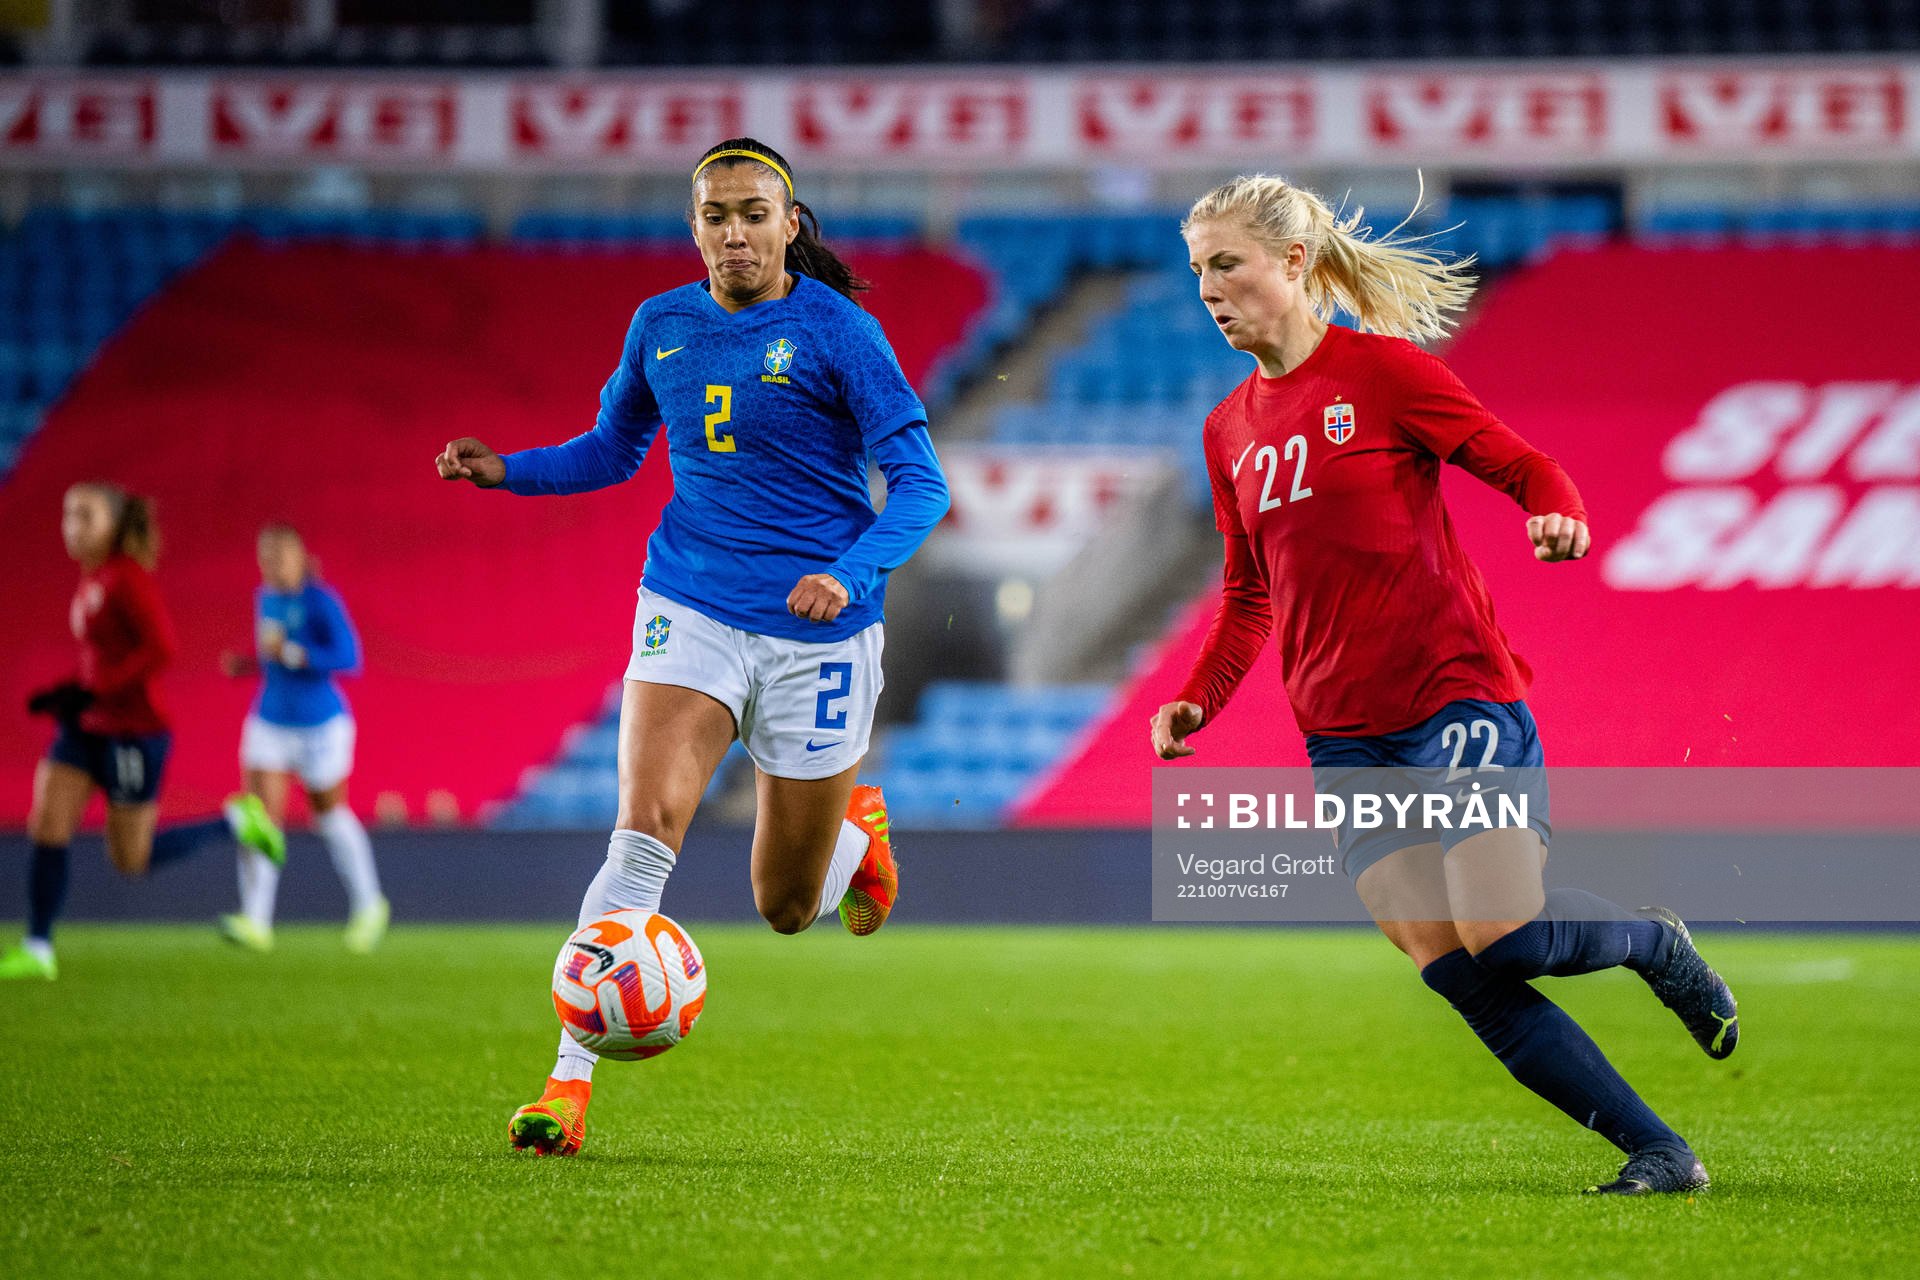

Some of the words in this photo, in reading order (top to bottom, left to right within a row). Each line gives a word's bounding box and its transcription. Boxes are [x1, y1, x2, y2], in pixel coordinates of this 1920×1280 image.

[214, 78, 454, 157] VG
[796, 77, 1027, 156] VG
[1073, 75, 1313, 155] VG
[1365, 73, 1604, 154] VG
[1658, 70, 1902, 152] VG
[704, 384, 737, 453] 2
[761, 375, 791, 384] BRASIL
[1254, 434, 1314, 513] 22
[640, 649, 667, 657] BRASIL
[815, 662, 853, 729] 2
[1441, 719, 1505, 784] 22
